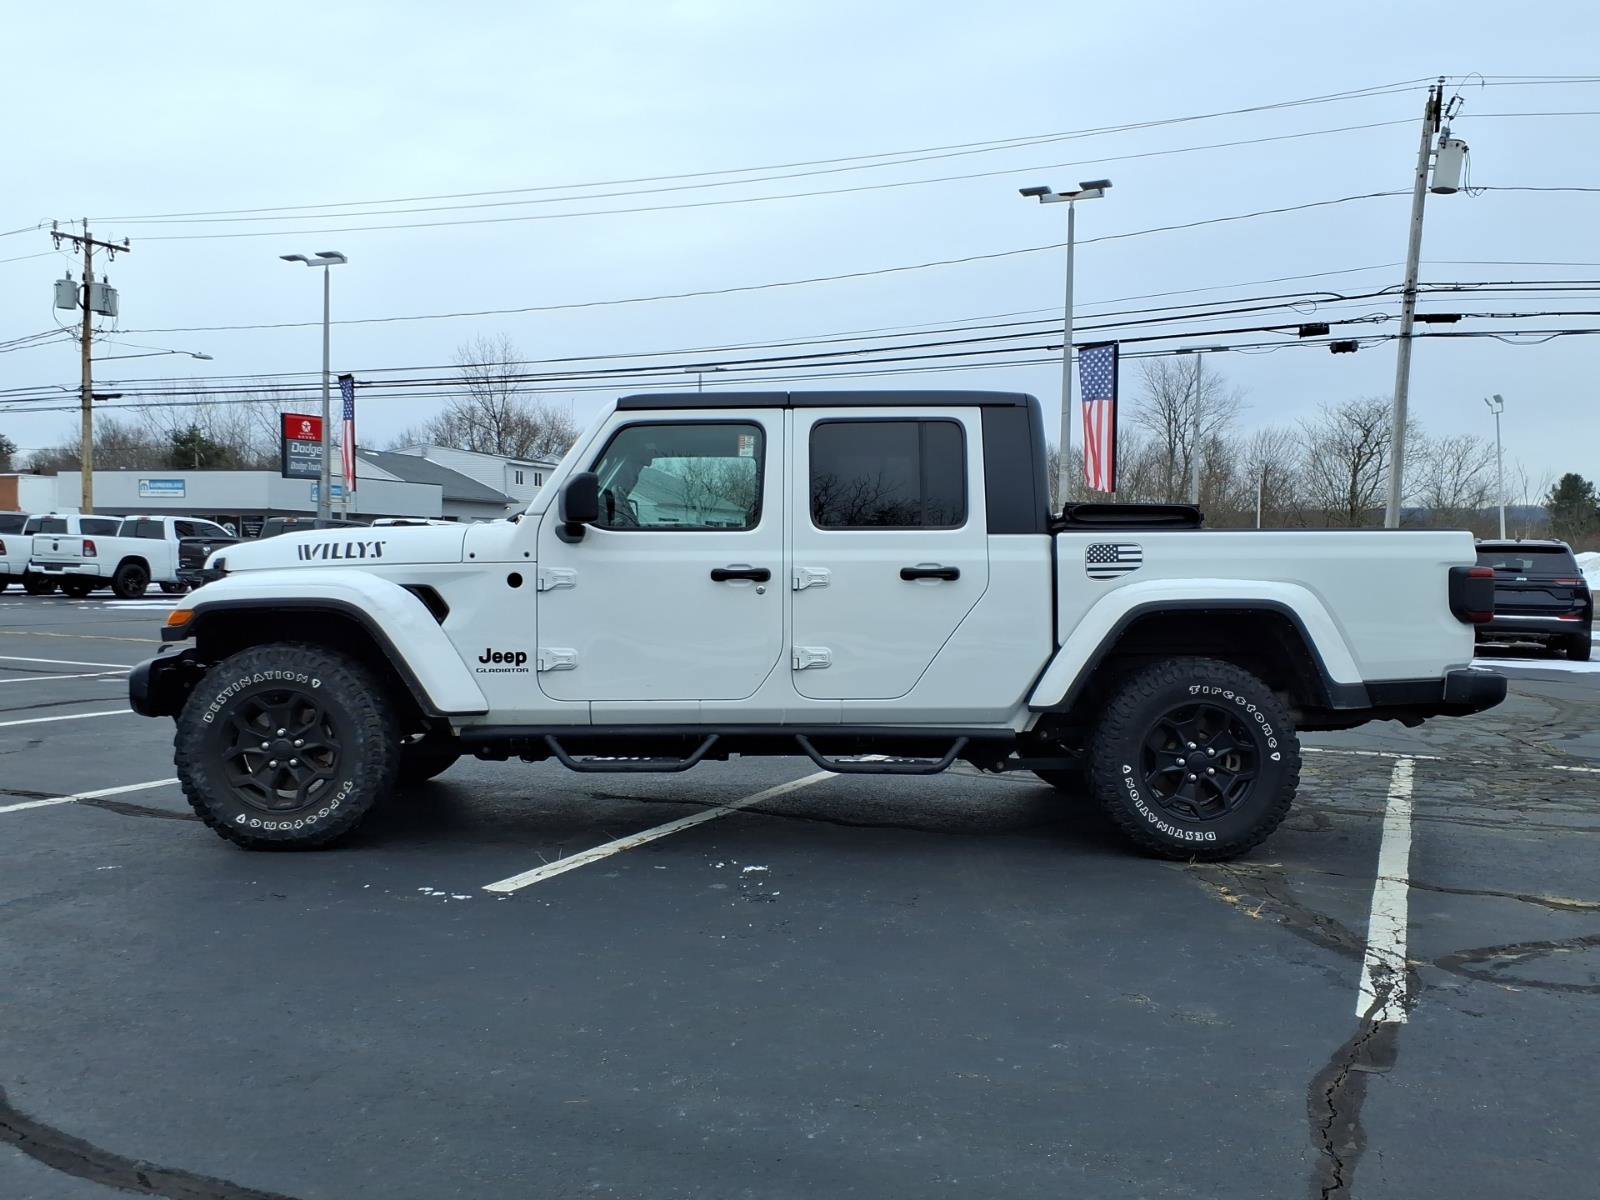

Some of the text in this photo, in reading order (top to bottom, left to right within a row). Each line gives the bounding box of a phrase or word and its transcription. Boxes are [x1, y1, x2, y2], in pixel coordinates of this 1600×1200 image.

[291, 442, 322, 457] Dodge
[297, 541, 387, 560] WILLYS
[478, 648, 527, 666] Jeep
[203, 670, 308, 724] DESTINATION
[1124, 777, 1216, 841] DESTINATION
